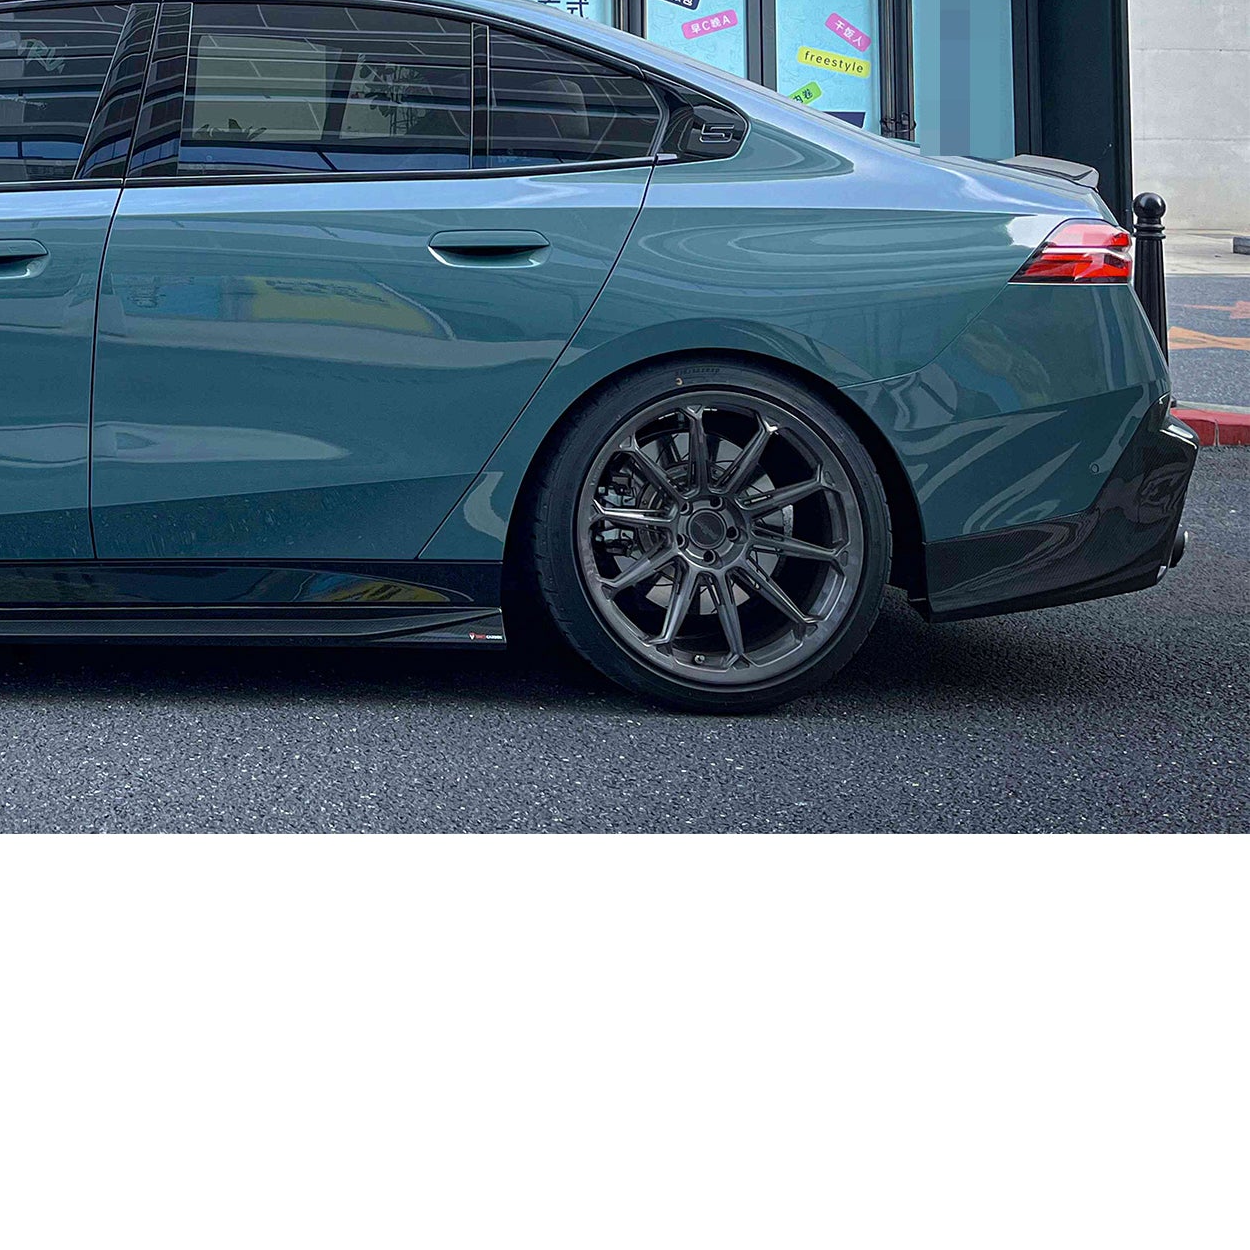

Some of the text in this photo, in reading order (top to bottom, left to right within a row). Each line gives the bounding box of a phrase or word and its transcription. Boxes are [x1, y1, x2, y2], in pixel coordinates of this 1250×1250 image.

[835, 20, 863, 47] 干饭人
[805, 50, 864, 73] freestyle
